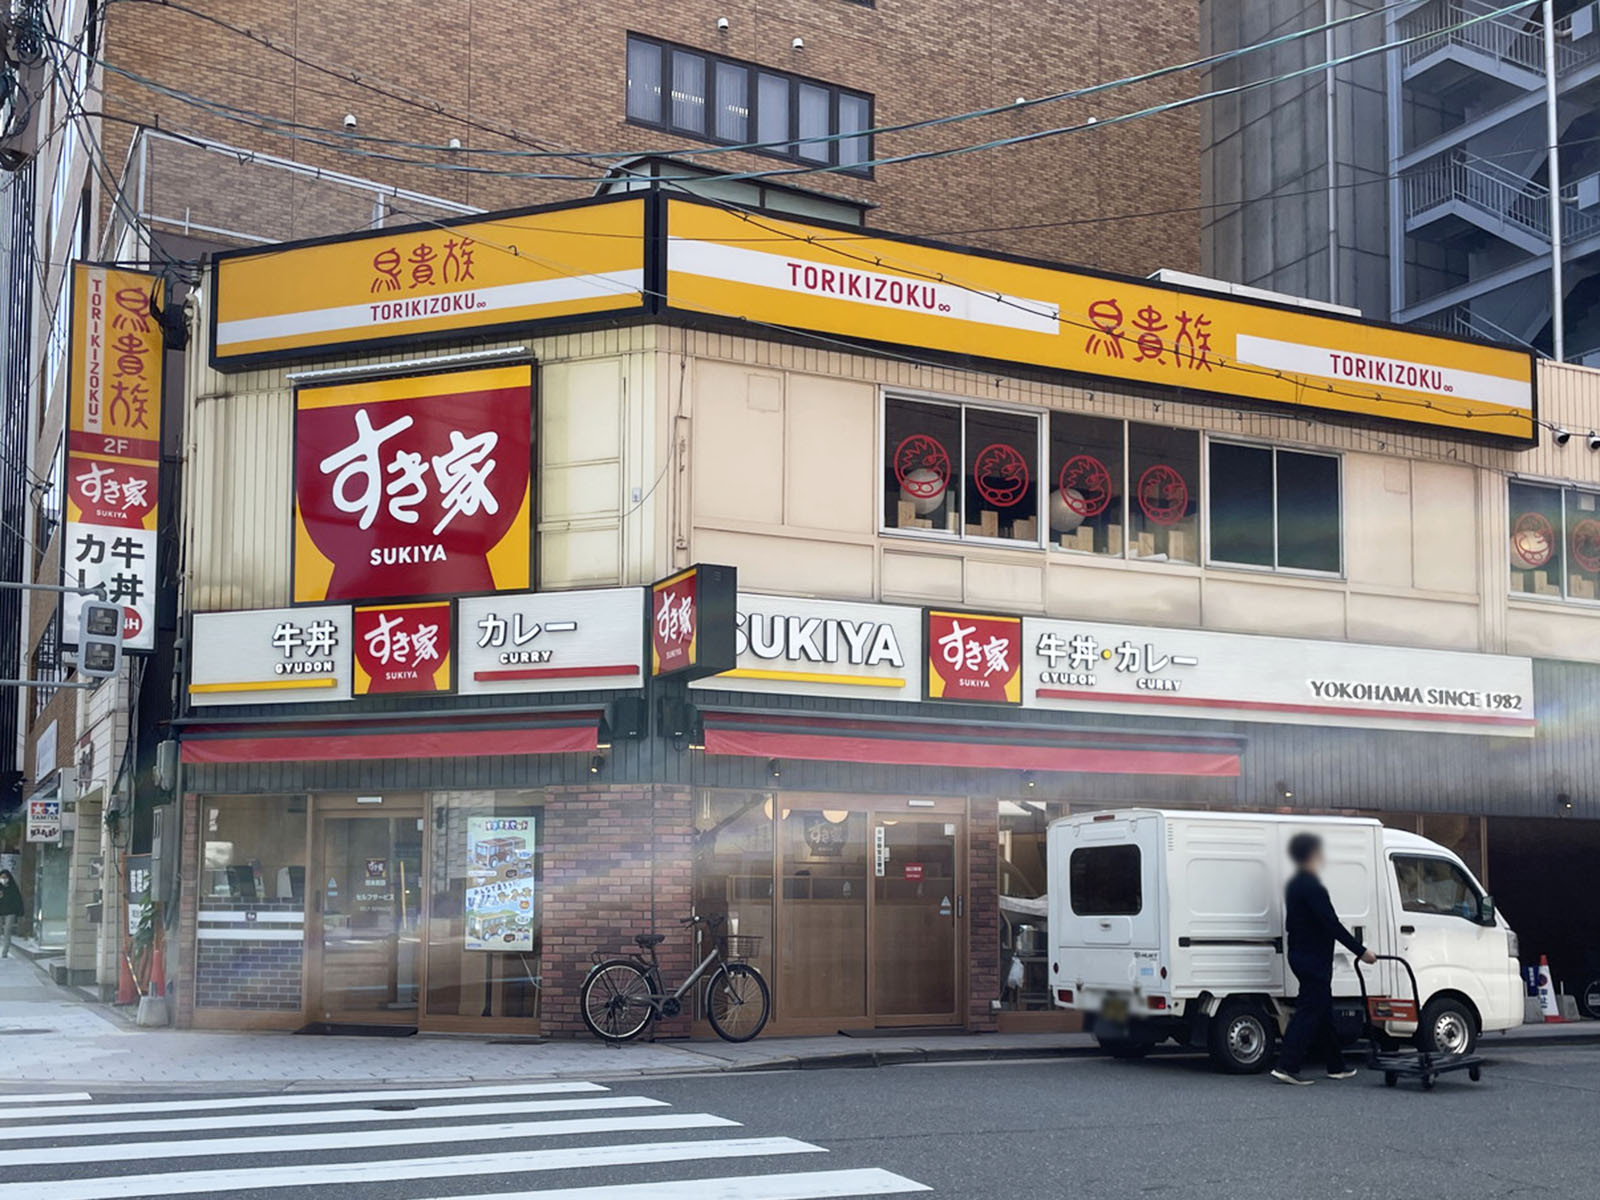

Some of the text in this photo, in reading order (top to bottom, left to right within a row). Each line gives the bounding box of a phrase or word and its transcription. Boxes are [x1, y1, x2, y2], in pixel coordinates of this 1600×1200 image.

[103, 438, 129, 454] 2F
[76, 462, 148, 510] すき家
[320, 408, 499, 536] すき家
[96, 509, 128, 519] SUKIYA
[75, 533, 107, 597] カレ
[370, 544, 447, 566] SUKIYA
[110, 537, 145, 606] 牛丼
[477, 613, 578, 648] カレー
[656, 591, 692, 645] すき家
[272, 620, 338, 658] 牛丼
[364, 613, 439, 668] すき家
[937, 620, 1010, 677] すき家
[275, 660, 334, 675] GYUDON
[499, 650, 553, 665] CURRY
[385, 671, 418, 680] SUKIYA
[959, 678, 990, 688] SUKIYA
[1040, 672, 1182, 691] GYUDON CURRY
[1311, 681, 1522, 711] YOKOHAMA SINCE 1982
